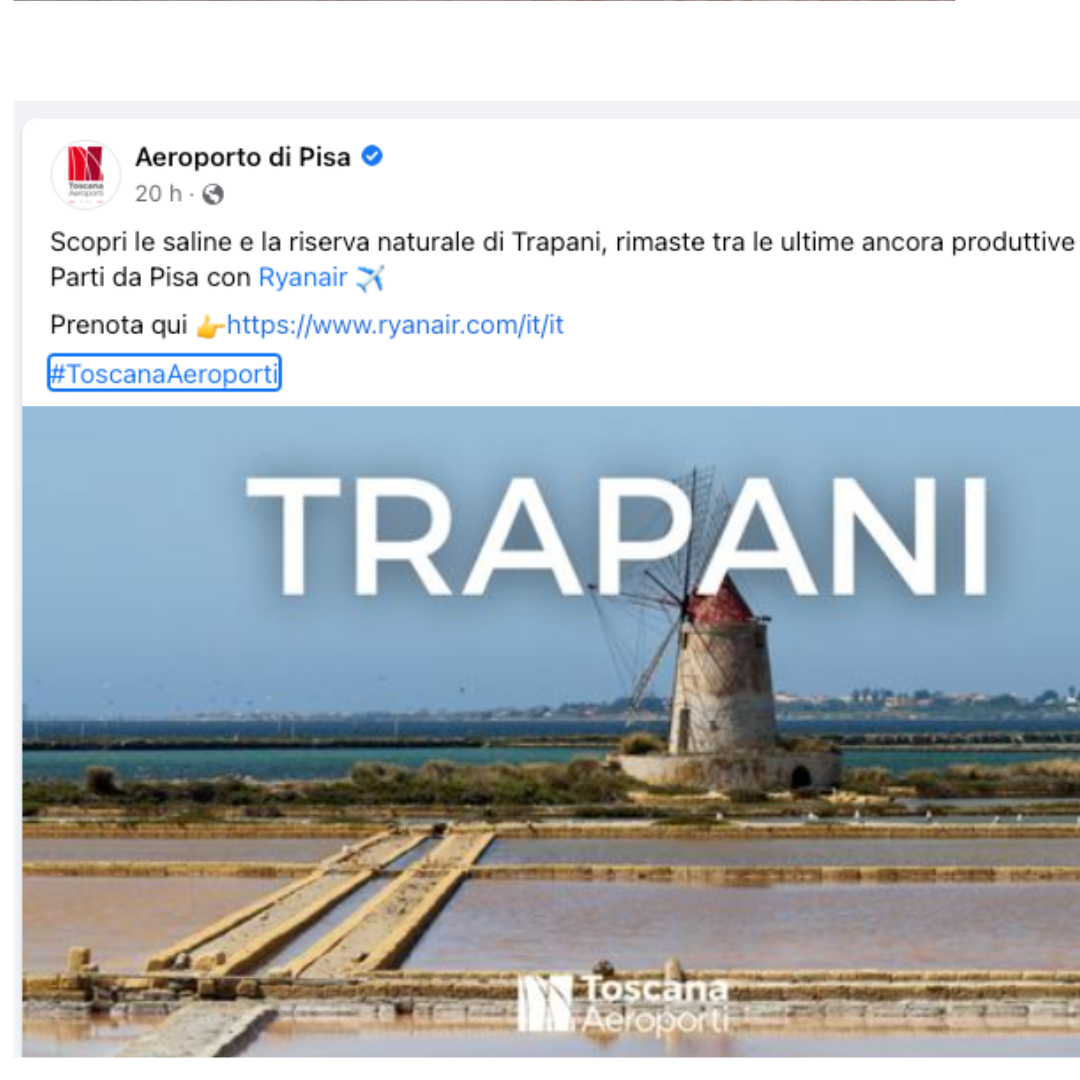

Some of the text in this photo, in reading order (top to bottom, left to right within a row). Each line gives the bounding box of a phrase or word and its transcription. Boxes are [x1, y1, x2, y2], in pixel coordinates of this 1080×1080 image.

[135, 145, 351, 172] Aeroporto di Pisa
[135, 183, 182, 203] 20 h
[50, 230, 128, 257] Scopri
[134, 230, 156, 252] le
[163, 230, 232, 252] saline
[239, 236, 254, 252] e
[261, 230, 282, 252] la
[289, 230, 370, 252] riserva
[378, 230, 476, 252] naturale
[482, 230, 504, 252] di
[511, 230, 607, 257] Trapani,
[616, 230, 706, 252] rimaste
[712, 232, 745, 252] tra
[753, 230, 774, 252] le
[781, 230, 855, 252] ultime
[861, 235, 944, 252] ancora
[952, 230, 1076, 257] produttive
[51, 265, 349, 292] Parti da Pisa con Ryanair
[51, 313, 564, 340] Prenota qui https://www.ryanair.com/it/it
[50, 362, 279, 390] #ToscanaAeroporti
